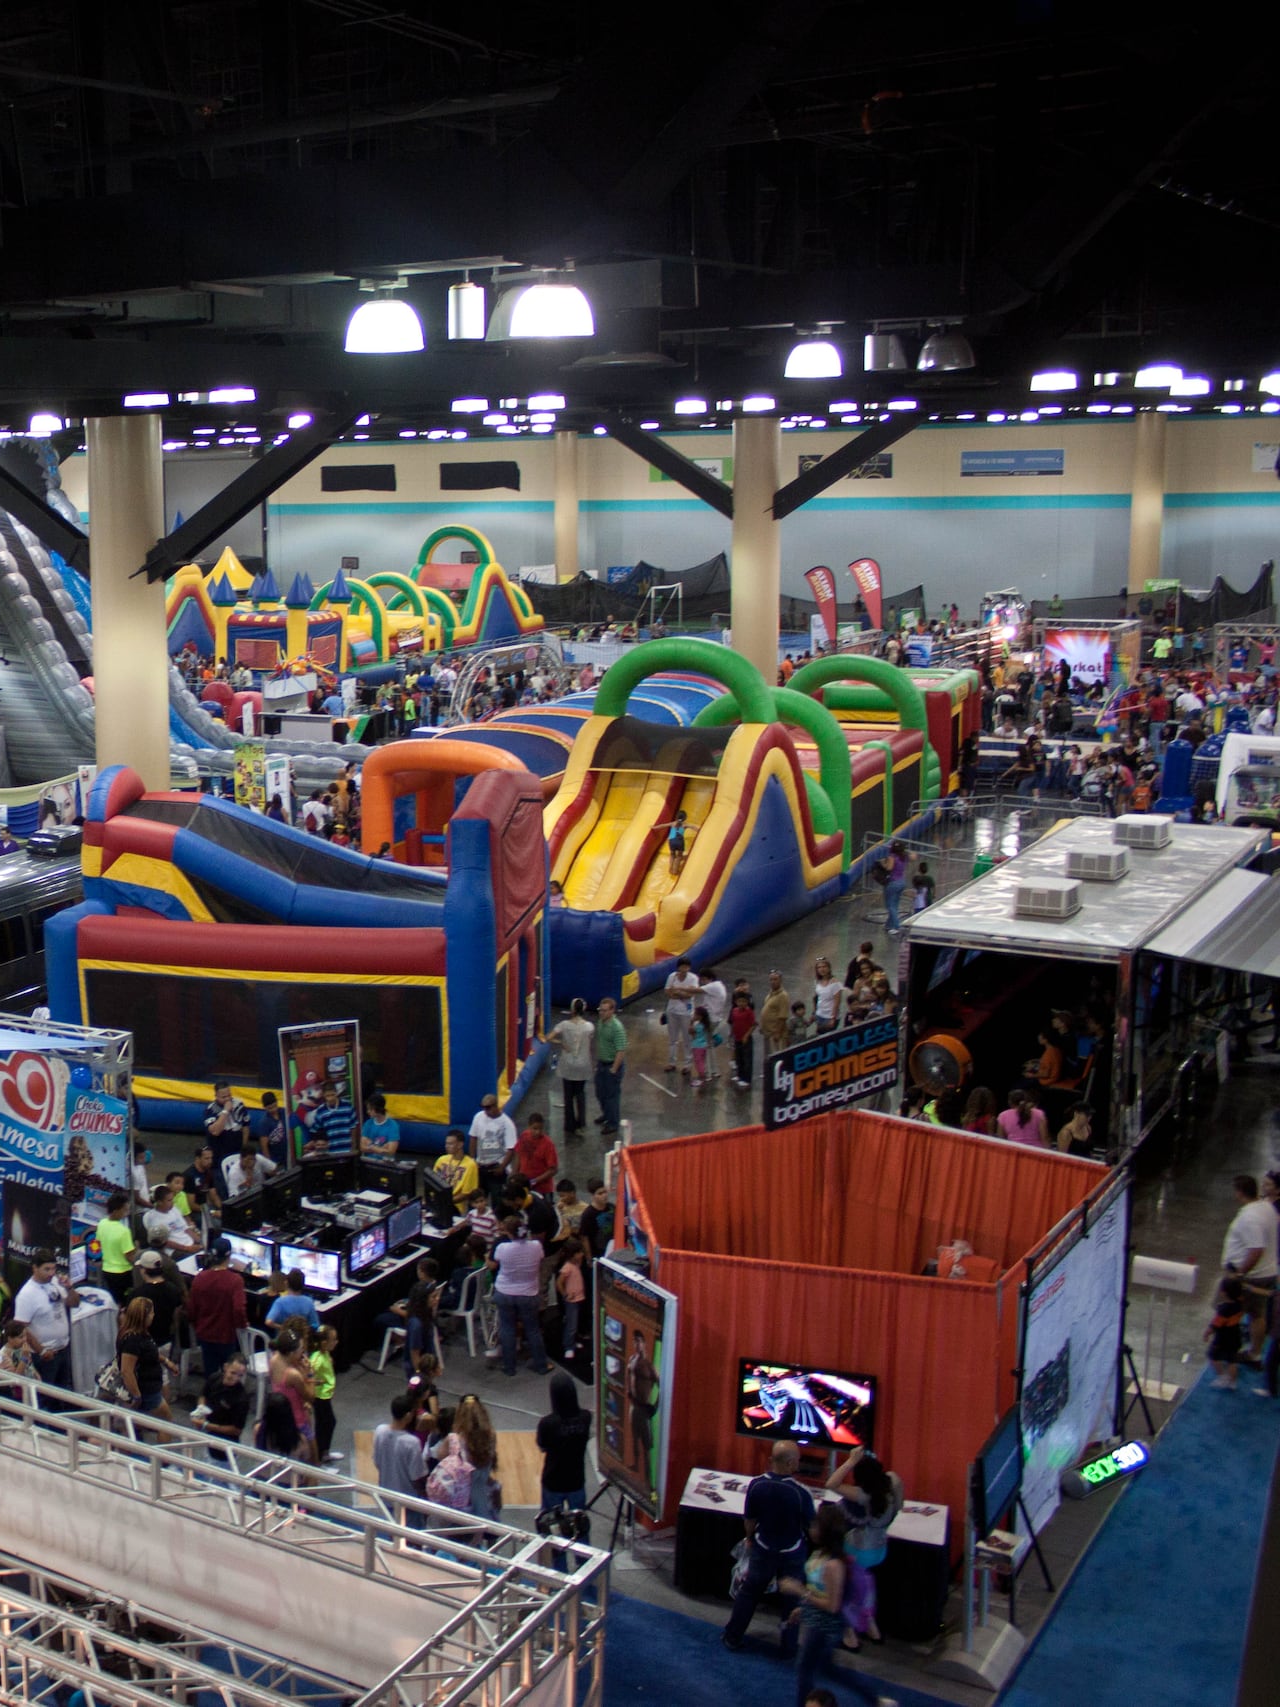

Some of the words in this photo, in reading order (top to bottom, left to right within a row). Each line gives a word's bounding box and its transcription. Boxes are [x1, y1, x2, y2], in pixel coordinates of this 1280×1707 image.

[793, 1021, 897, 1072] BOUNDLESS
[794, 1041, 898, 1098] GAMES
[773, 1068, 897, 1123] bgamespr.com
[70, 1112, 124, 1135] CHUNKS
